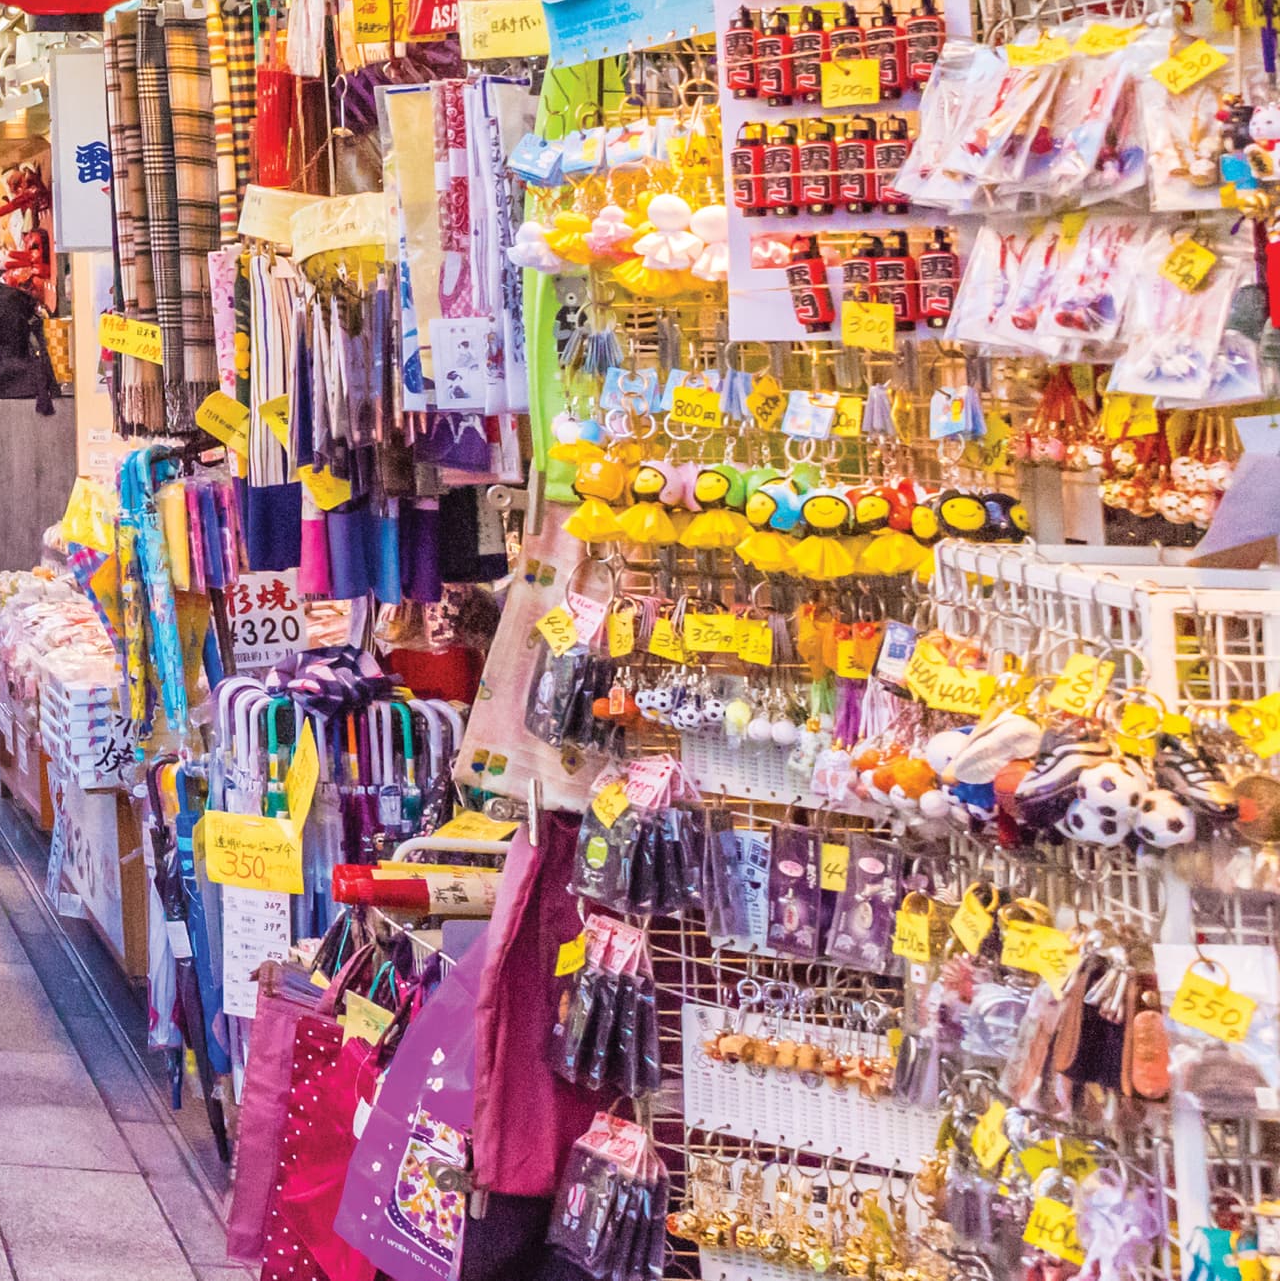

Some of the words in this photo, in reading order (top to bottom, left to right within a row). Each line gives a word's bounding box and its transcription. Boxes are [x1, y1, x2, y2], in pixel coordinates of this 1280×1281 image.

[1166, 52, 1213, 88] 430
[220, 850, 267, 880] 350
[1185, 991, 1251, 1035] 550
